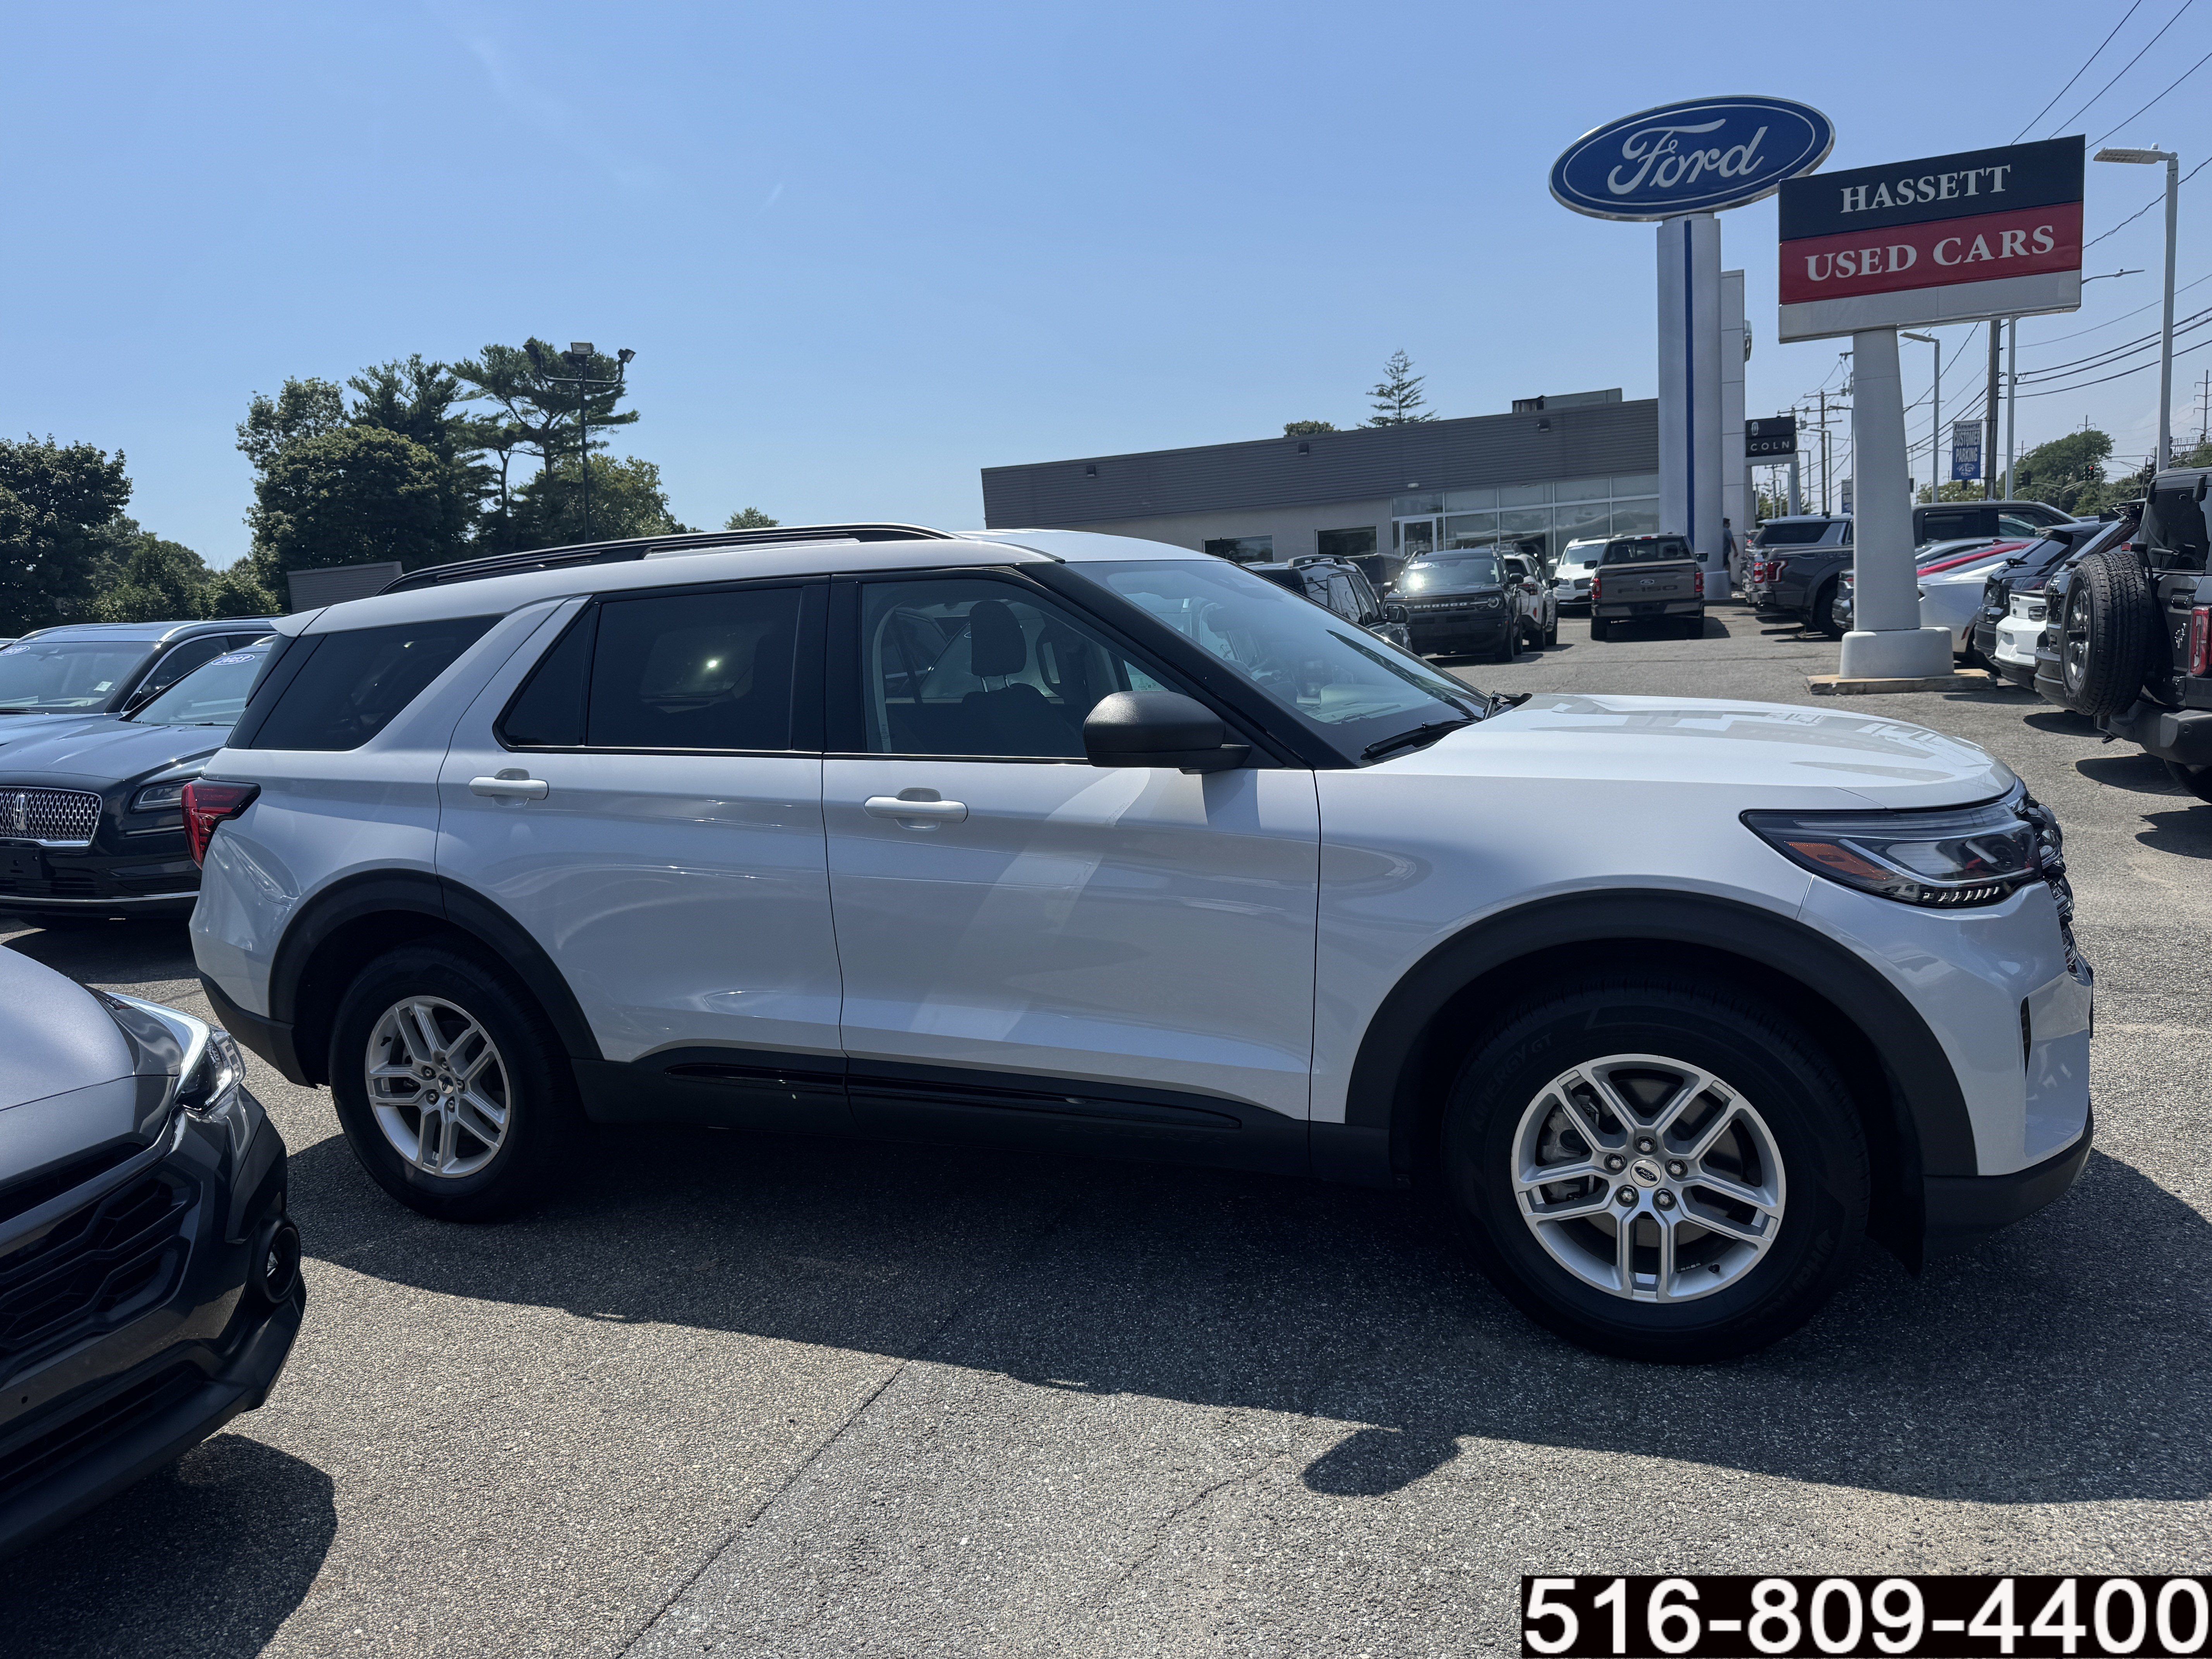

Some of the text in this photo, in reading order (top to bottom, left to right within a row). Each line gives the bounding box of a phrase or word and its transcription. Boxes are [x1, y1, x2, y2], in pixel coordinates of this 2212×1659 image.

[1607, 118, 1768, 195] Ford
[1840, 164, 2011, 214] HASSETT
[1805, 225, 2054, 281] USED CARS
[1750, 441, 1790, 452] COLN
[1954, 431, 1980, 447] CUSTOMER
[1956, 447, 1977, 462] PARKING
